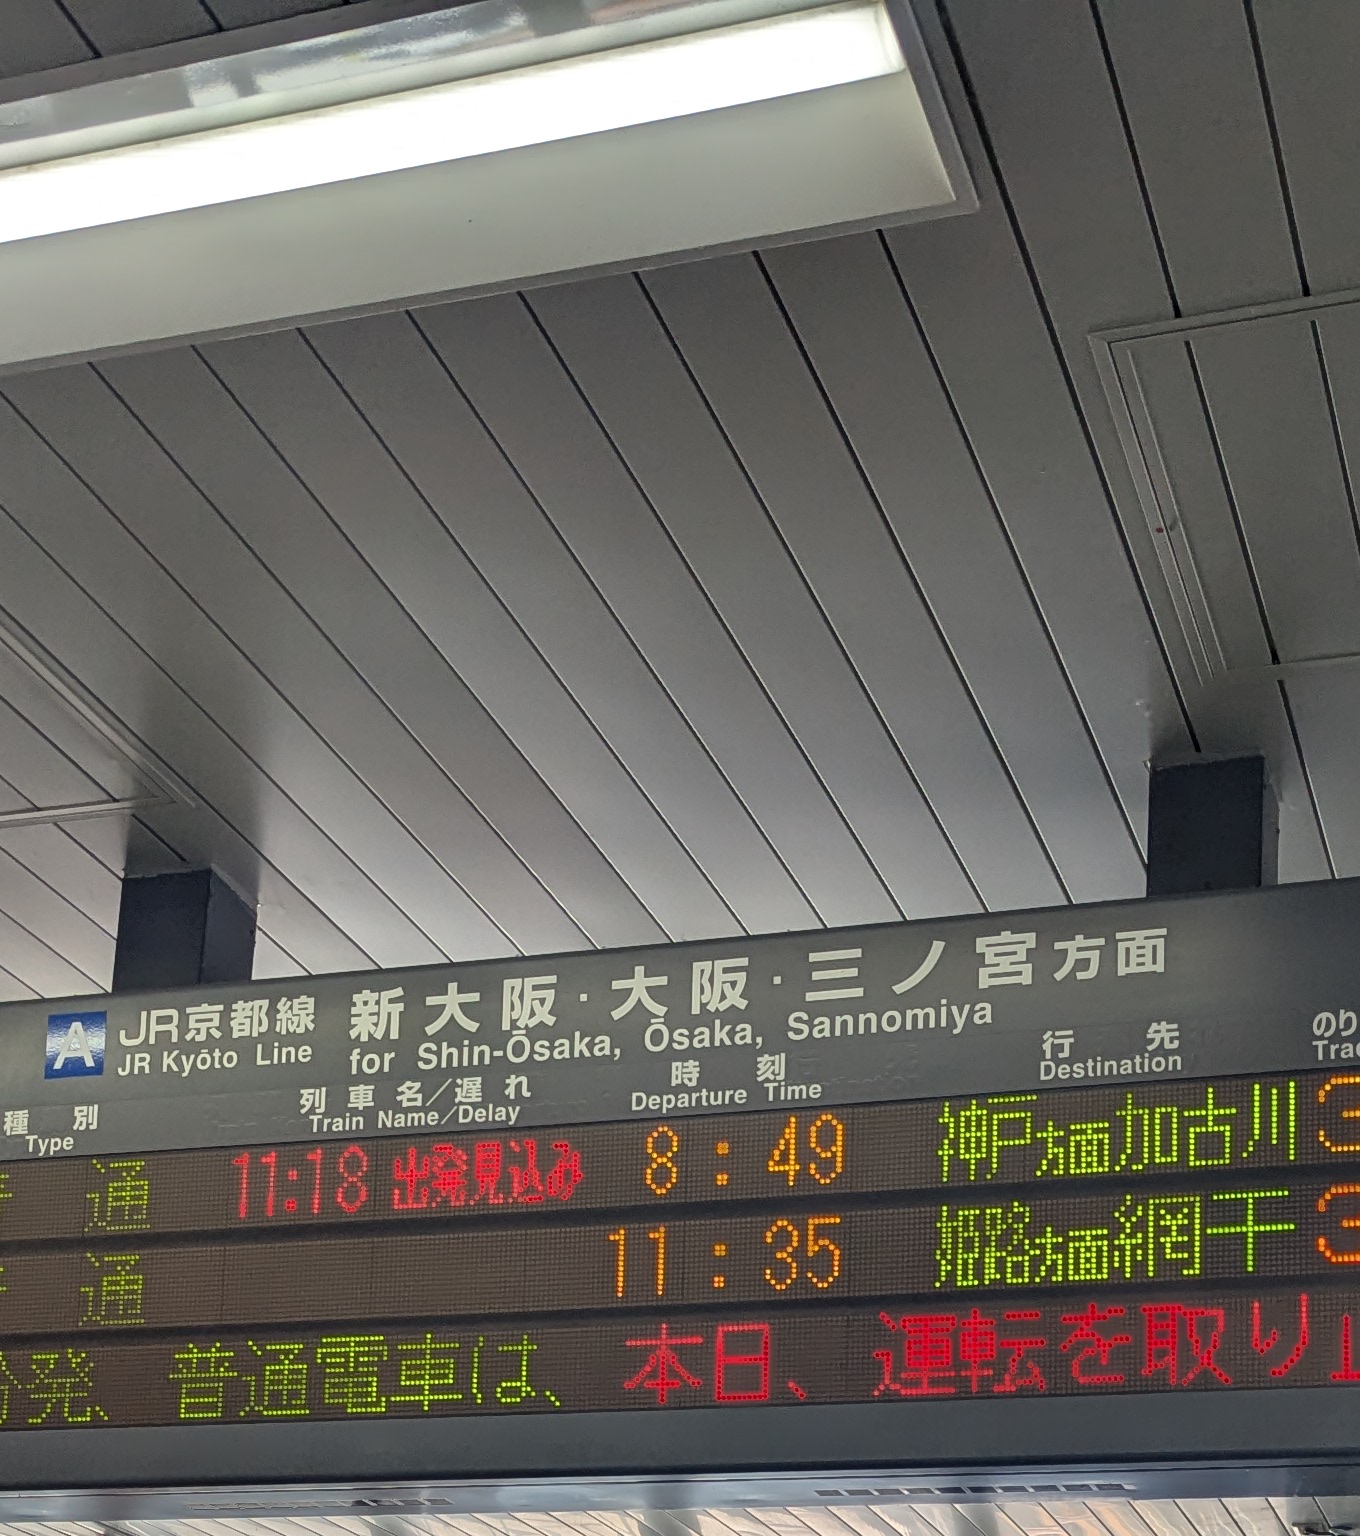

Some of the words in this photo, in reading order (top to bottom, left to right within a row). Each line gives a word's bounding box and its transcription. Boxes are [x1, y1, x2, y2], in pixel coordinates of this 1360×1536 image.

[117, 1052, 149, 1077] JR
[162, 1046, 238, 1078] Kyōto
[256, 1042, 313, 1066] Line
[349, 1047, 395, 1075] for
[417, 1030, 621, 1072] Shin-Ōsaka,
[644, 1017, 763, 1054] Ōsaka,
[787, 999, 993, 1041] Sannomiya
[119, 996, 316, 1047] JR京都線
[53, 1022, 95, 1071] A
[1040, 1053, 1182, 1081] Destination
[632, 1085, 748, 1114] Departure
[764, 1080, 822, 1102] Time
[310, 1111, 364, 1134] Train
[377, 1103, 520, 1132] Name/Delay
[26, 1135, 74, 1155] Type
[232, 1142, 369, 1219] 11:18
[392, 1138, 583, 1211] 出発見込み
